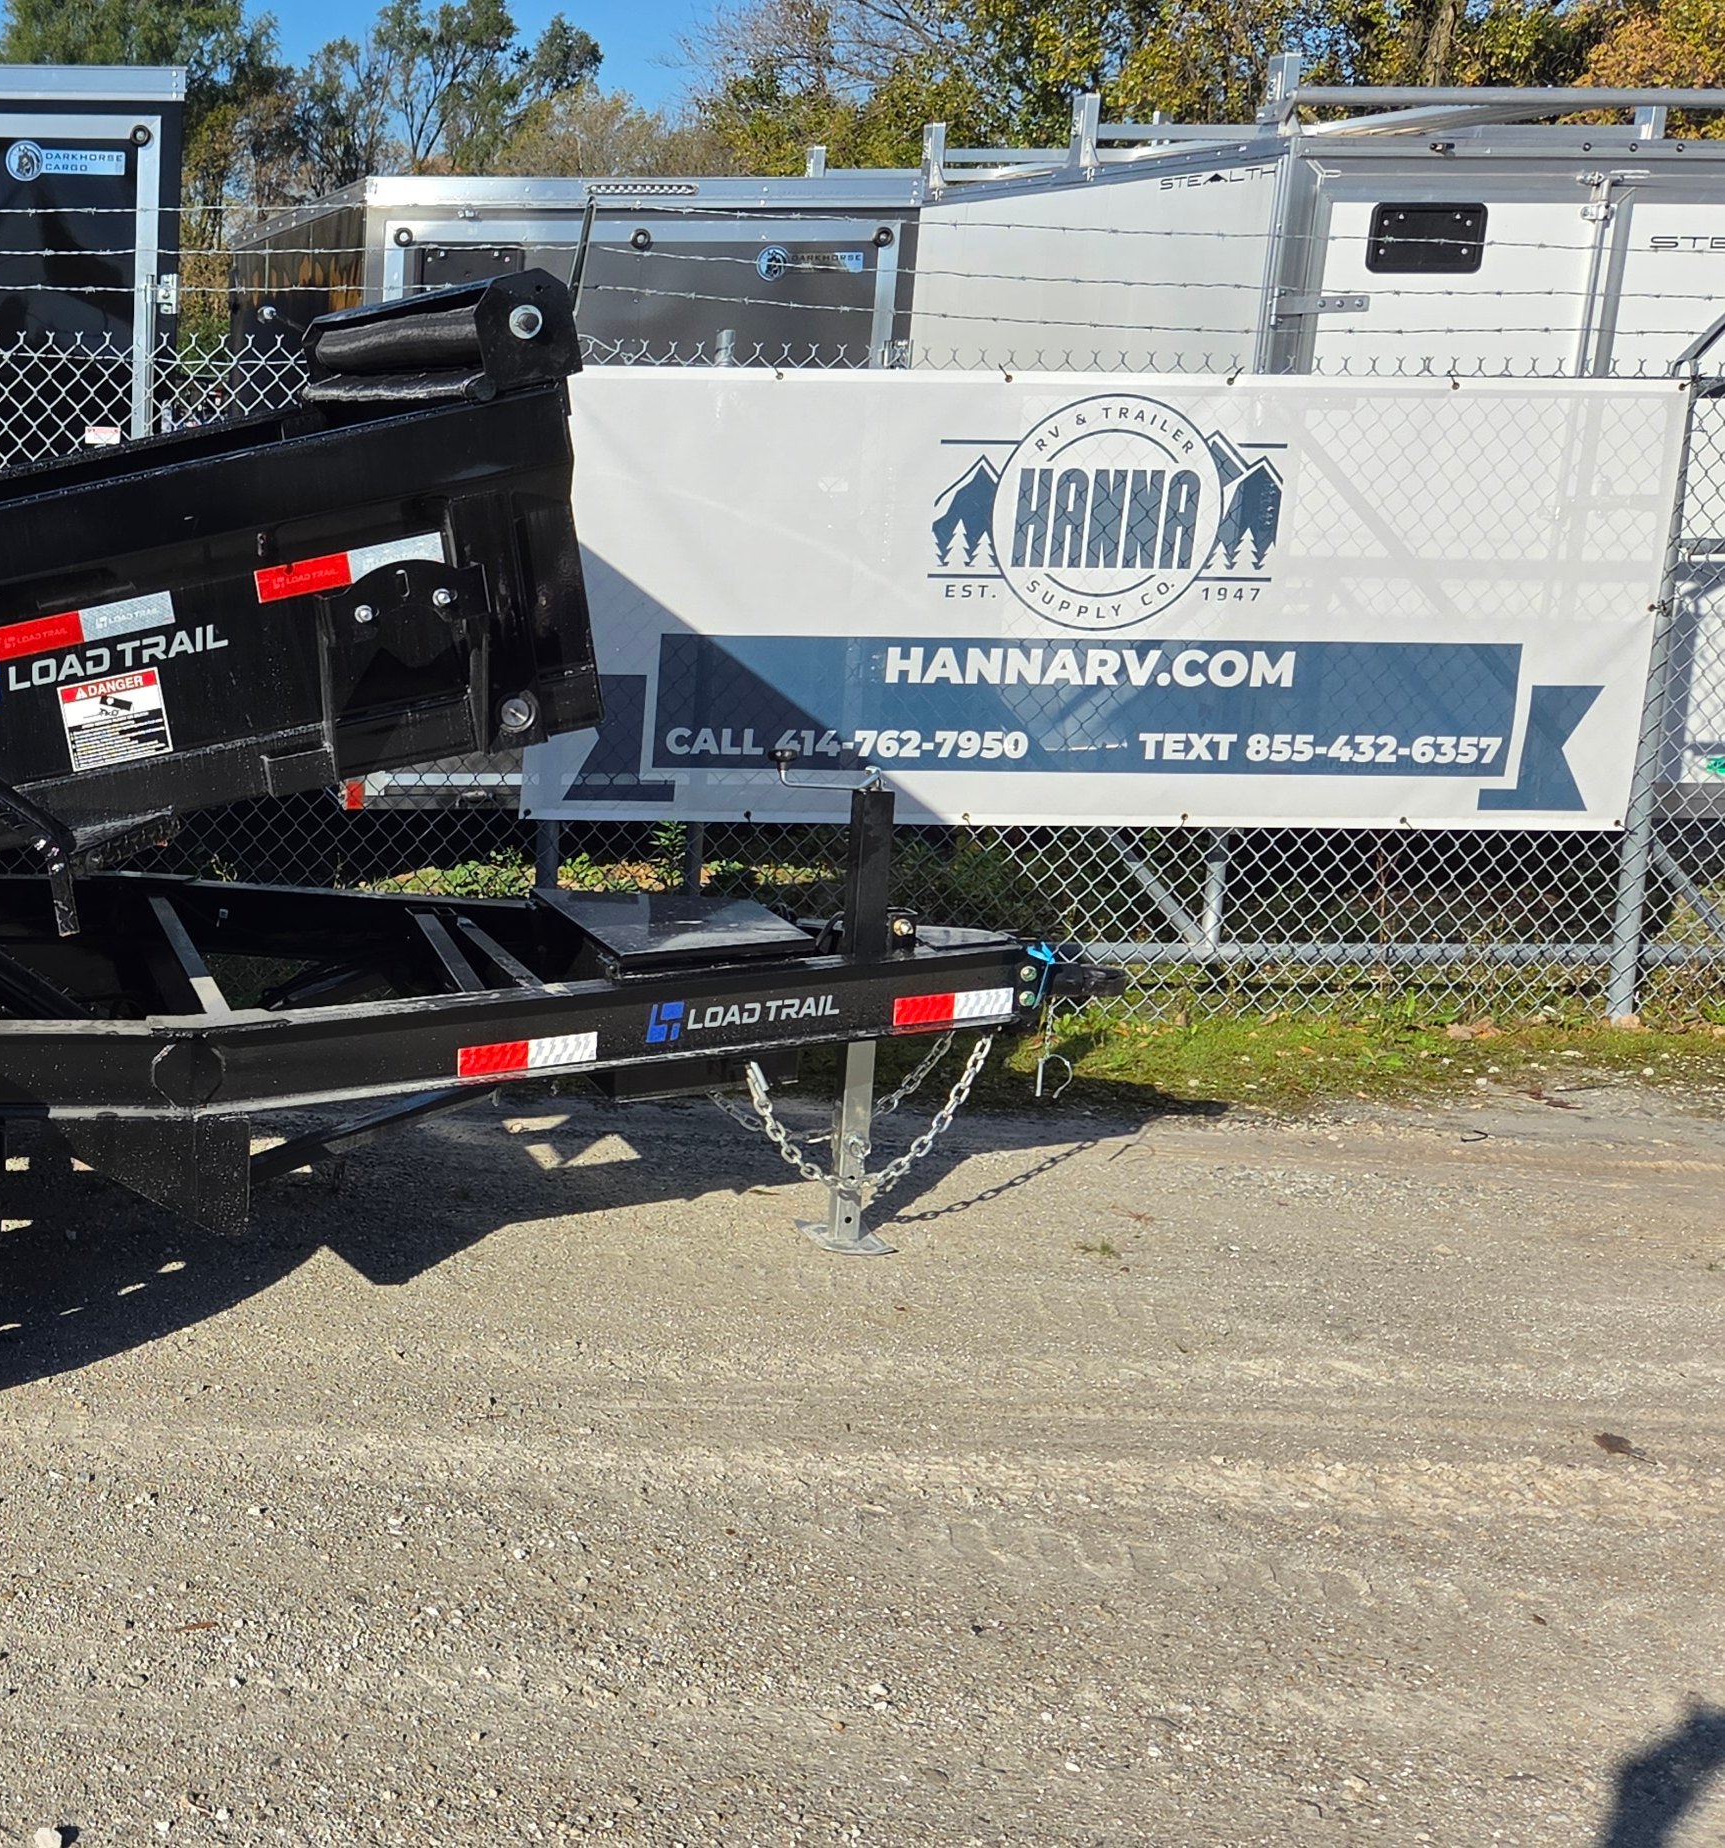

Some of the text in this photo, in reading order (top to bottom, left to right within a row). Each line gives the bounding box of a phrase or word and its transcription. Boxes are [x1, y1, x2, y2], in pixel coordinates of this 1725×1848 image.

[45, 152, 123, 162] DARKHORSE
[45, 163, 88, 172] CARGO
[1034, 406, 1195, 455] RV & TRAILER
[1011, 466, 1202, 570] HANNA
[944, 583, 997, 599] EST.
[1025, 579, 1175, 619] SUPPLY CO.
[1201, 586, 1261, 602] 1947
[7, 646, 111, 692] LOAD
[116, 623, 230, 667] TRAIL
[885, 646, 1297, 688] HANNARV.COM
[86, 674, 144, 697] DANGER
[665, 727, 1029, 760] CALL 414-762-7950
[1138, 732, 1504, 765] TEXT 855-432-6357
[686, 1002, 762, 1031] LOAD
[766, 994, 841, 1022] TRAIL
